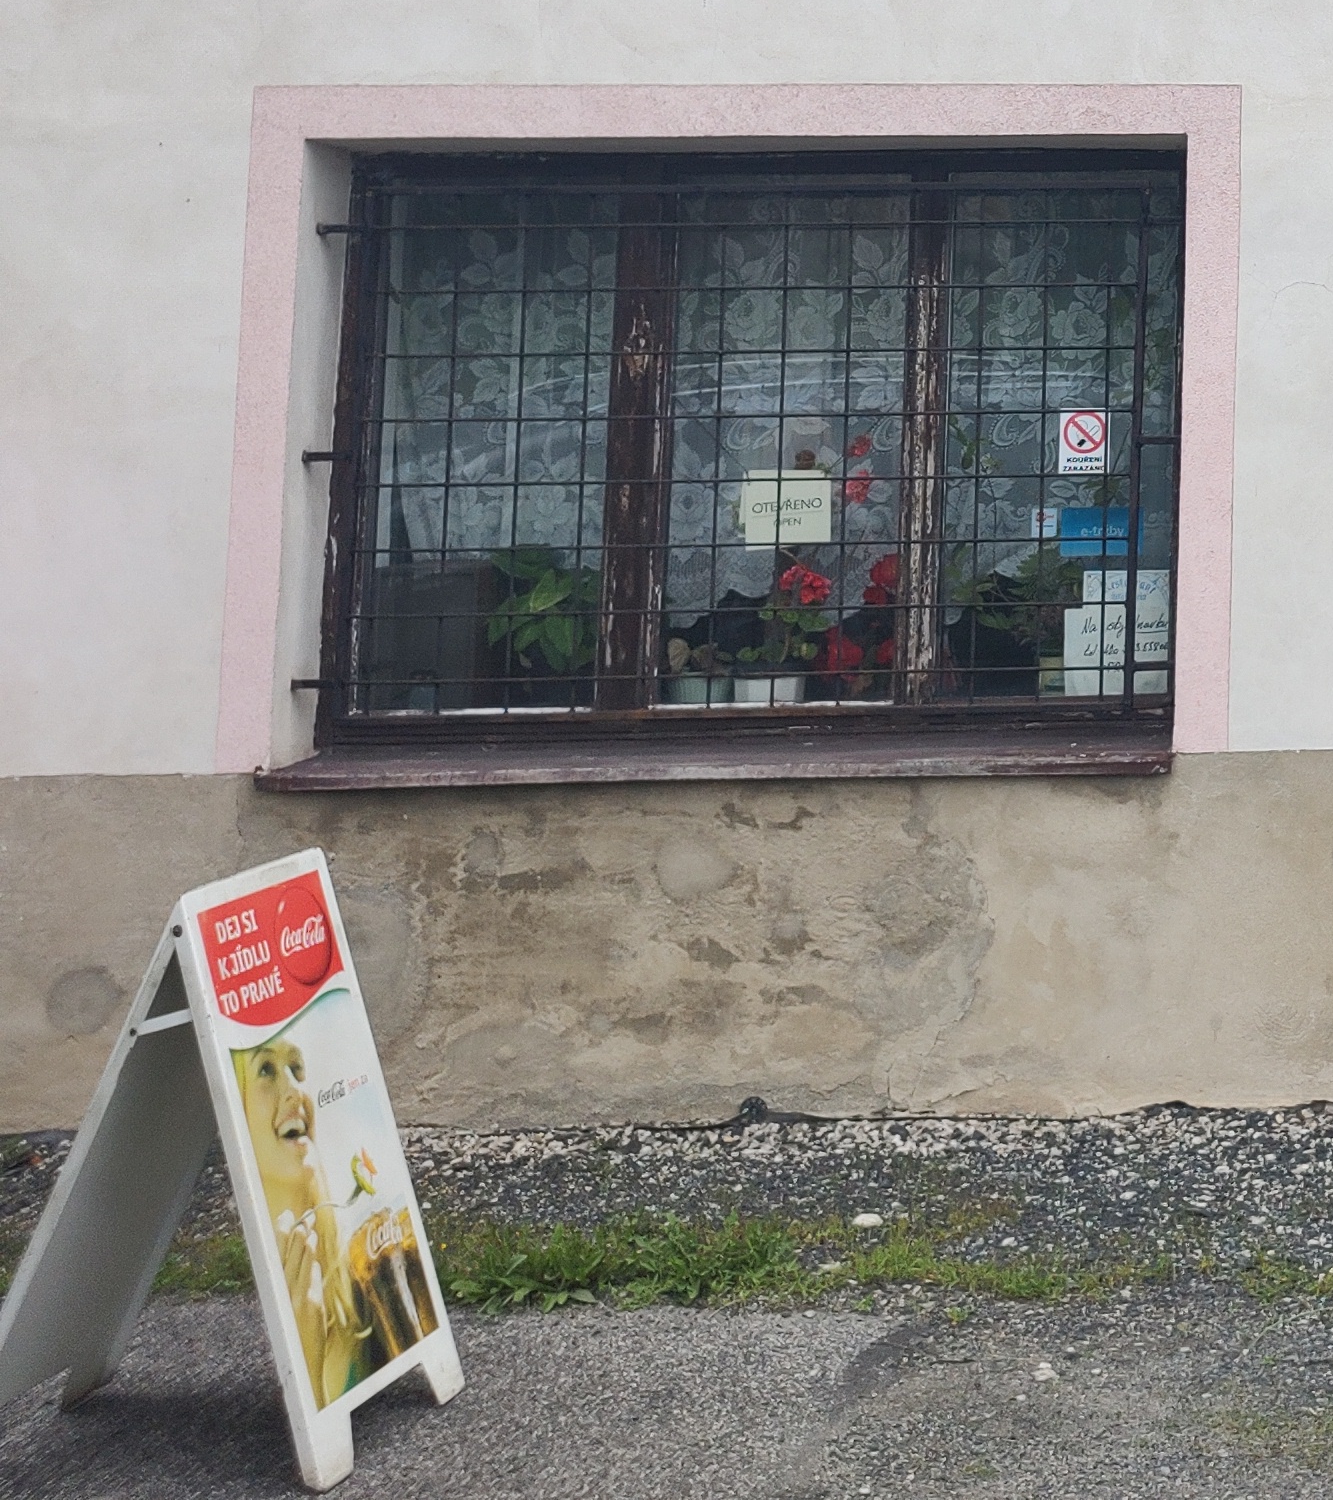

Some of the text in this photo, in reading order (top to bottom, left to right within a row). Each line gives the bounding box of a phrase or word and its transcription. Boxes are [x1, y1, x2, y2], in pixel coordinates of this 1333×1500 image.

[752, 496, 823, 514] OTEVŘENO
[215, 908, 259, 944] DEJ SI
[217, 940, 271, 981] K JÍDLU
[219, 964, 285, 1017] TO PRAVÉ
